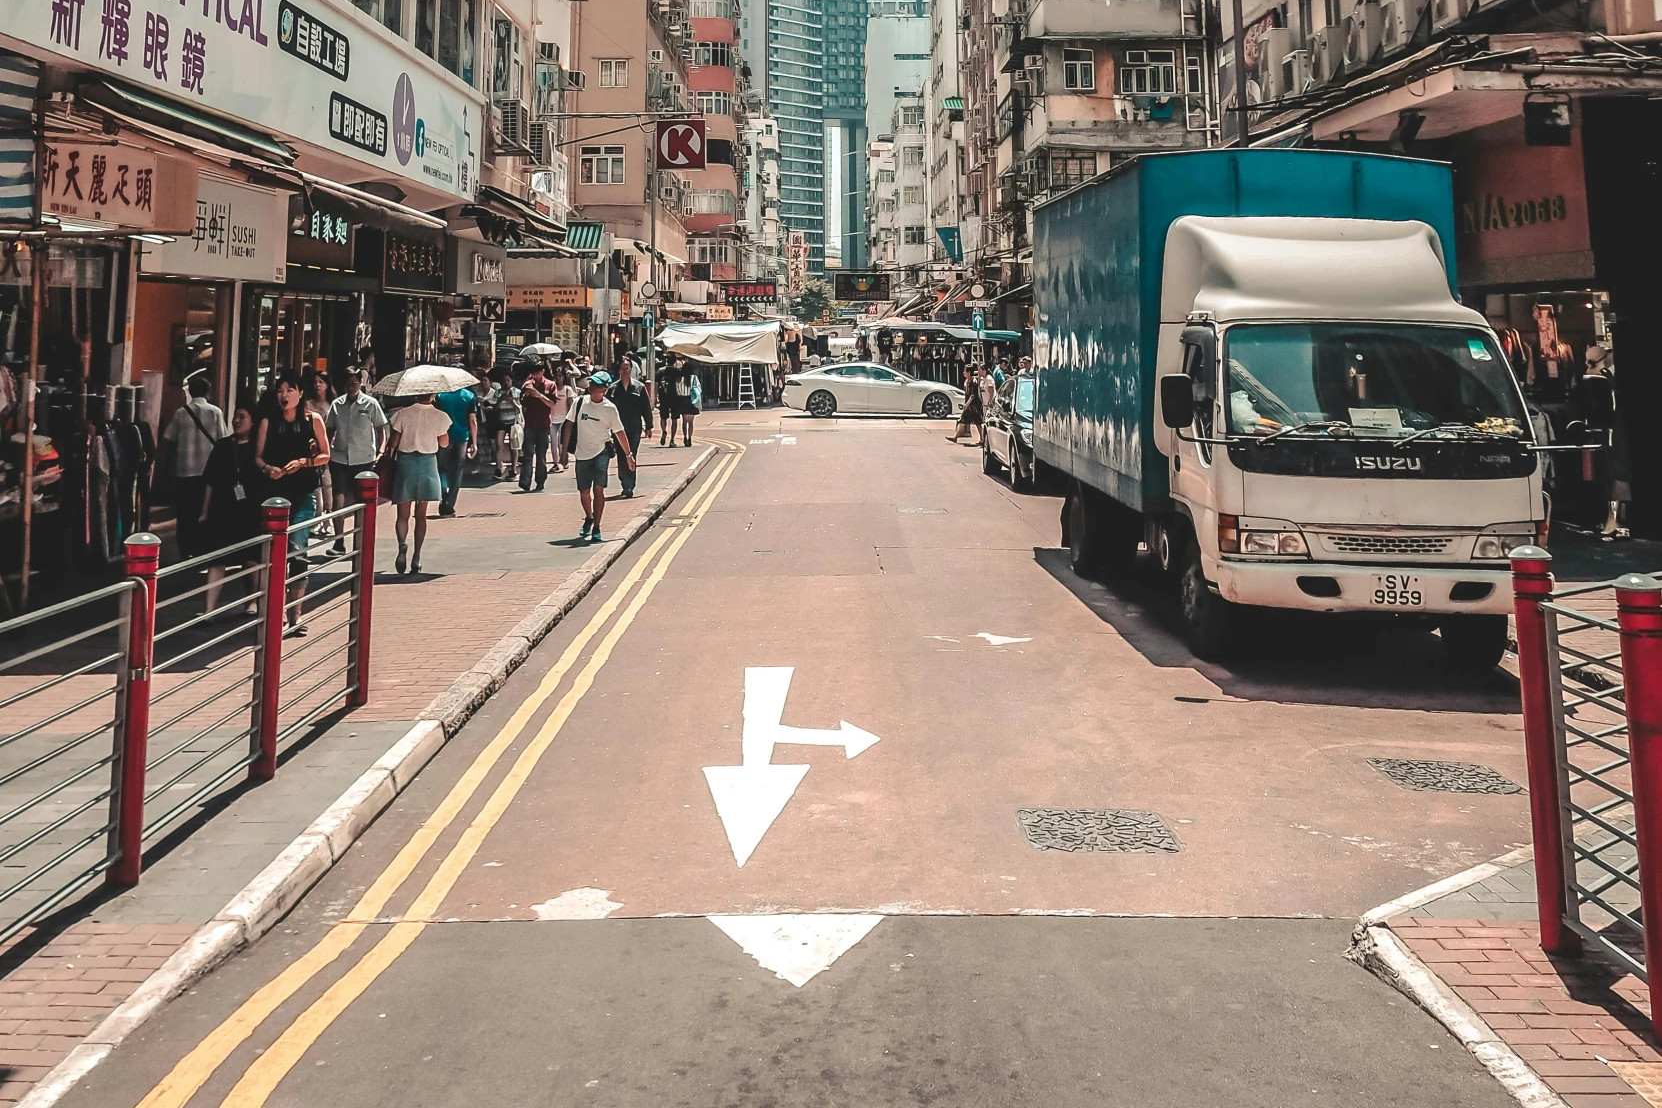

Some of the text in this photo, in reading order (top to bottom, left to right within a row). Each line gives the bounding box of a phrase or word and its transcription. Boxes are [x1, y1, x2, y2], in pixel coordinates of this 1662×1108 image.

[296, 15, 346, 76] 自設工場
[343, 102, 386, 152] 即配即有
[232, 224, 257, 245] SUSHI
[231, 244, 256, 259] TAKE-OUT
[1354, 455, 1421, 471] ISUZU
[1385, 575, 1410, 590] SV
[1373, 590, 1422, 606] 9959
